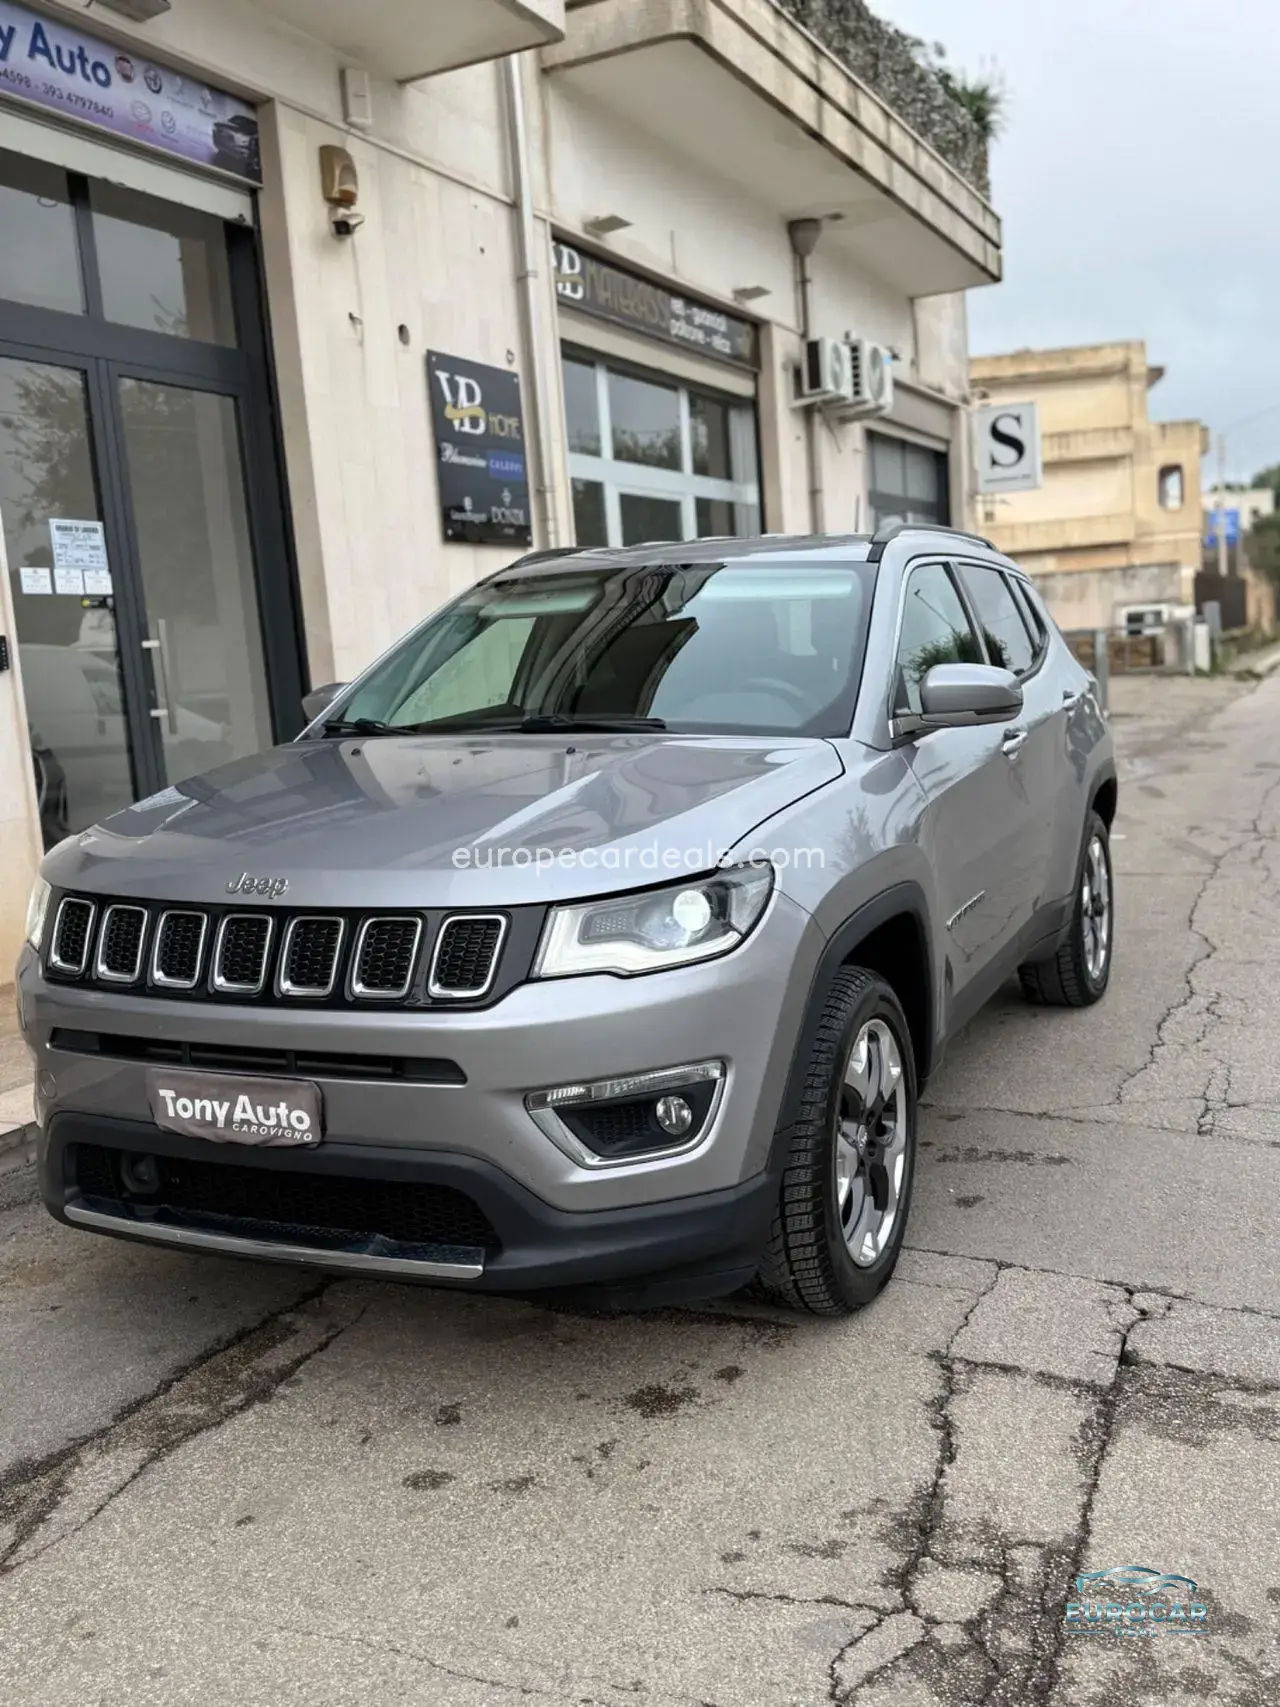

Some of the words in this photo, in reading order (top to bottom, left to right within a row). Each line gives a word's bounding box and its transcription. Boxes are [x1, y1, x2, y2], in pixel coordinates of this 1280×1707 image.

[28, 21, 112, 89] Auto
[989, 412, 1026, 470] S
[225, 872, 289, 900] Jeep
[158, 1089, 230, 1128] Tony
[232, 1095, 311, 1131] Auto
[232, 1123, 312, 1141] CAROVIGNO
